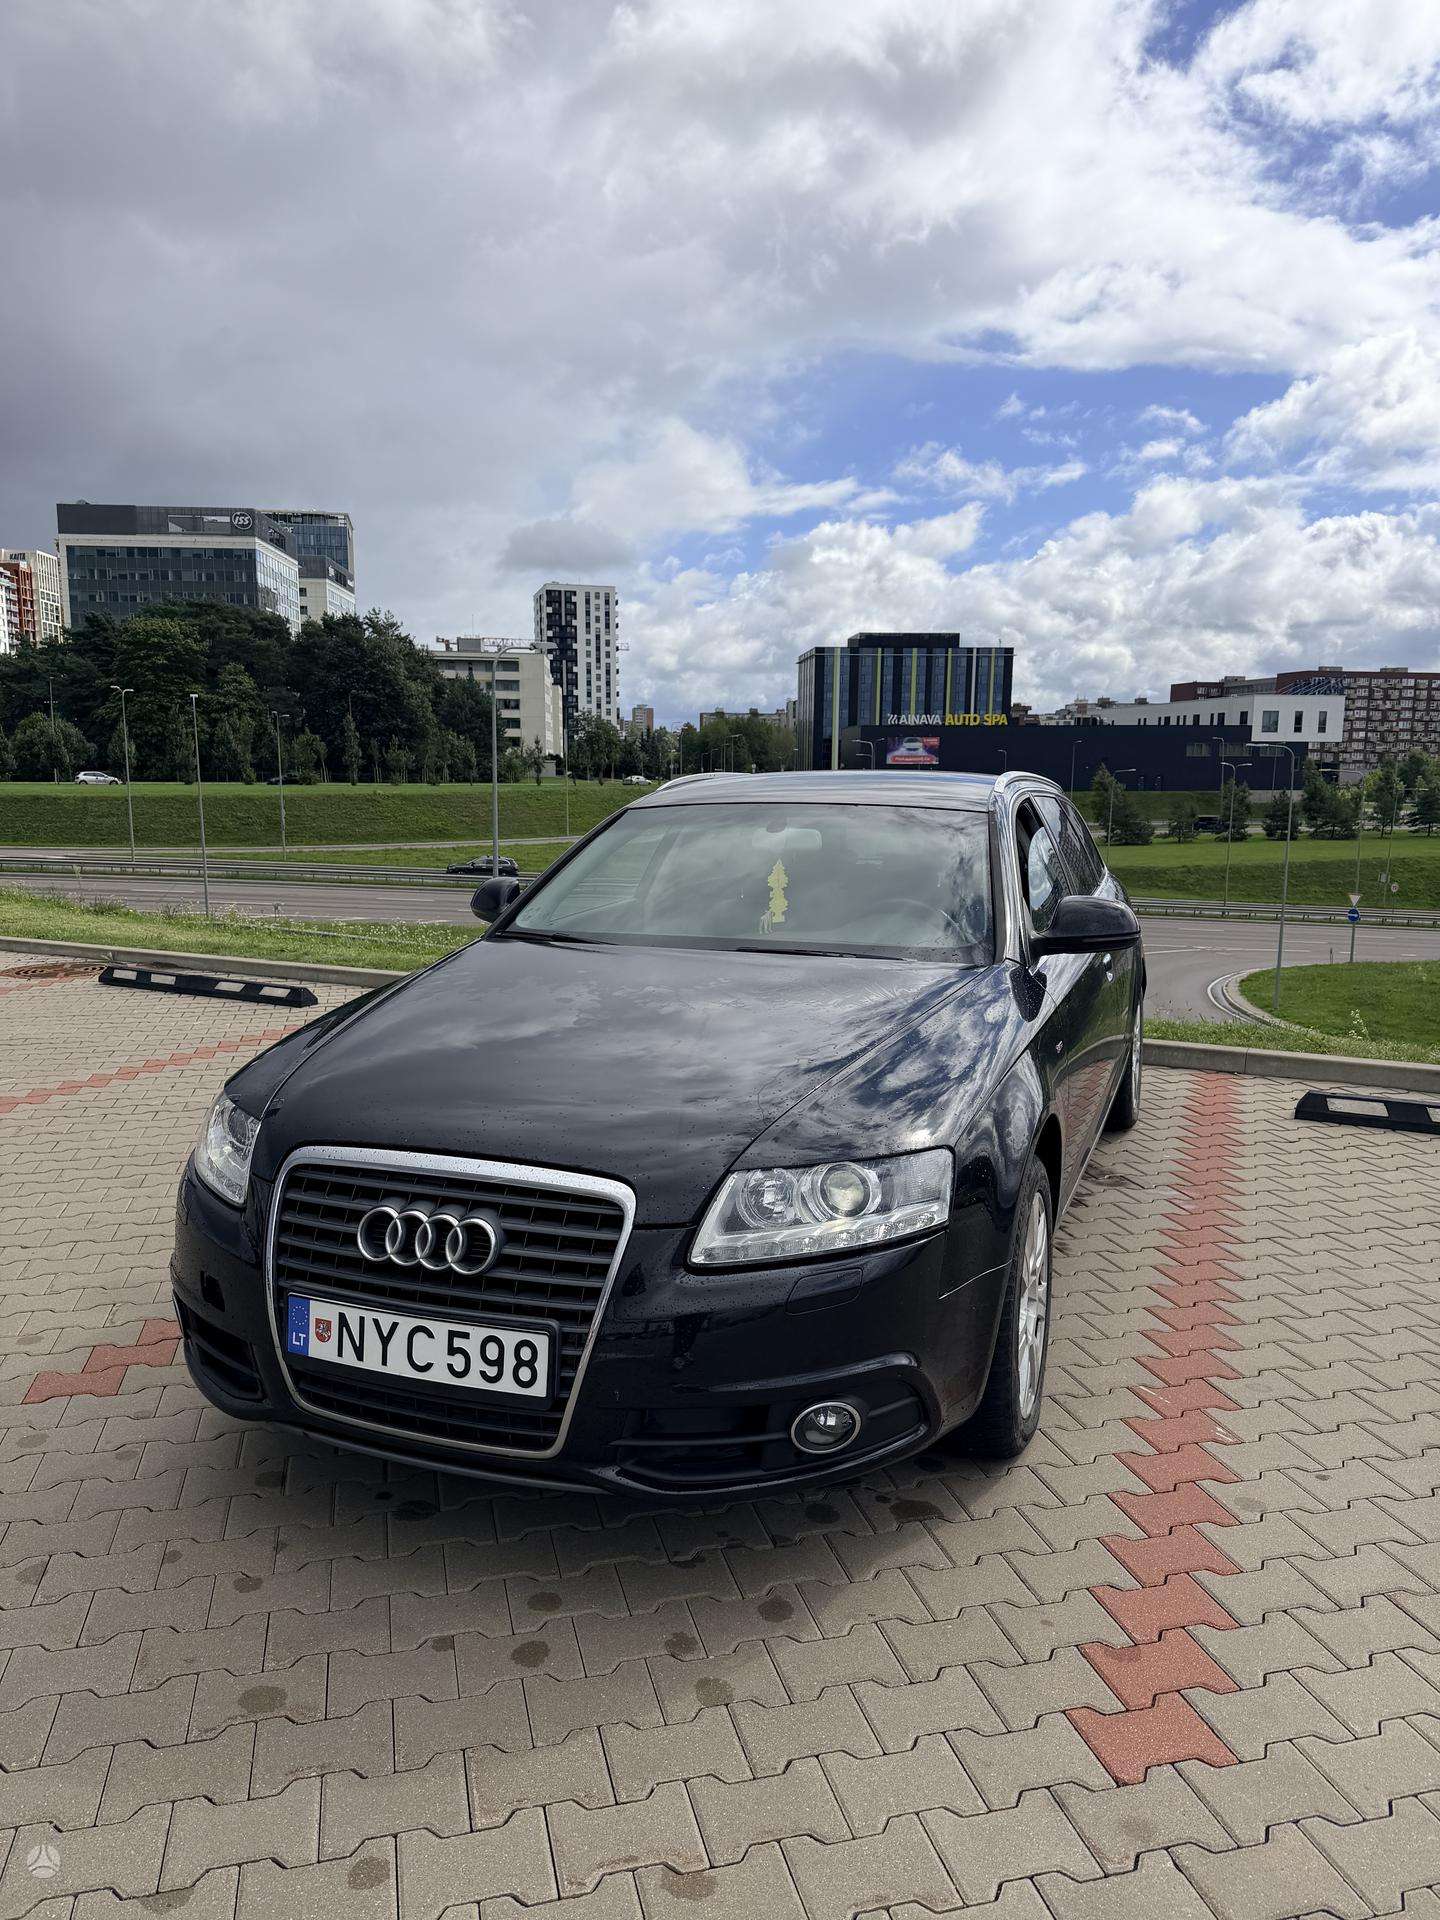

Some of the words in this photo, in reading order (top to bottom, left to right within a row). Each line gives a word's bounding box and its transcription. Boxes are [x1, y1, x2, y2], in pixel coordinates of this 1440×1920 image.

[945, 713, 981, 725] AUTO
[983, 713, 1008, 725] SPA
[292, 1331, 306, 1347] LT
